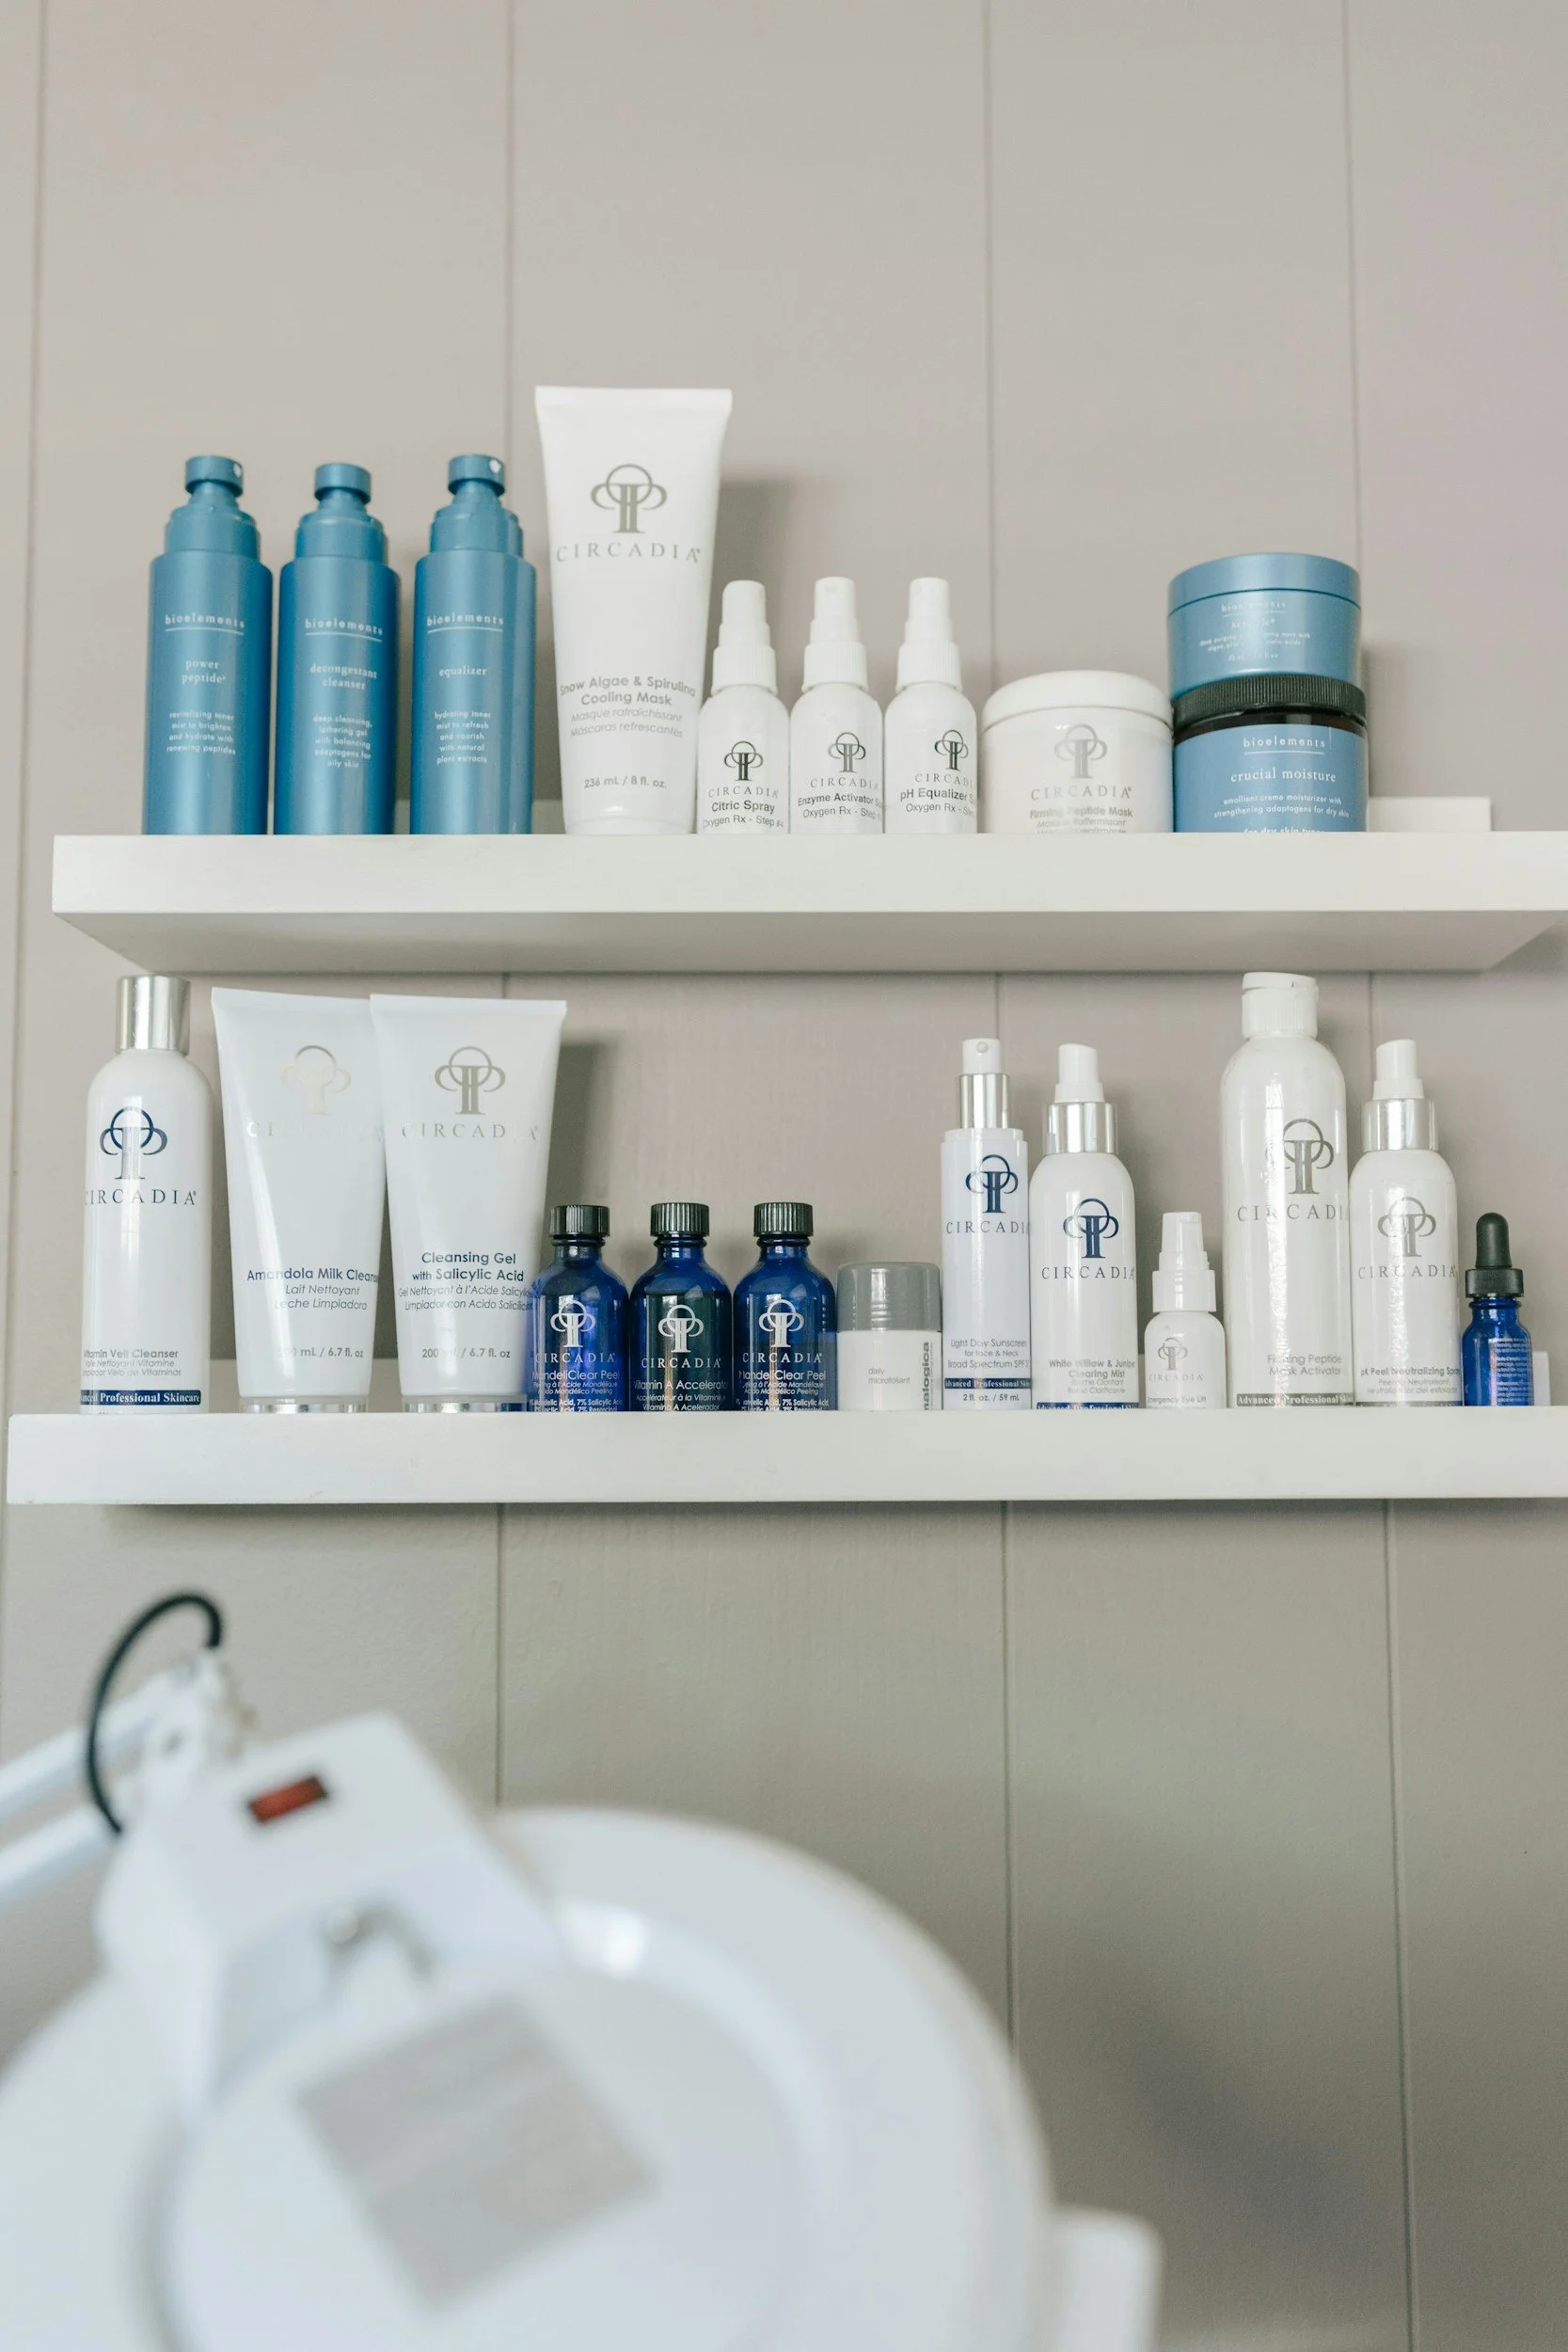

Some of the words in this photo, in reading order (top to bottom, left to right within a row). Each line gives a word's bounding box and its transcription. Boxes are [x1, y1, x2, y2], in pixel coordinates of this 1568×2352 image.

[556, 542, 698, 563] CIRCADIA
[165, 612, 245, 628] bioelements
[427, 612, 504, 627] bioelements
[305, 618, 383, 636] bioelements
[185, 660, 219, 670] power
[309, 663, 377, 678] decongestant
[439, 665, 487, 678] equalizer
[323, 676, 366, 690] cleanser
[589, 676, 628, 689] Algae
[634, 676, 642, 686] &
[580, 691, 632, 705] Cooling
[637, 692, 672, 706] Mask
[1243, 736, 1325, 748] bioelements
[631, 776, 637, 785] 8
[1230, 767, 1276, 783] crucial
[1282, 769, 1337, 783] moisture
[799, 795, 831, 806] Enzyme
[834, 793, 874, 803] Activator
[900, 788, 914, 802] pH
[918, 788, 967, 801] Equalizer
[1031, 786, 1130, 801] CIRCADIA
[712, 801, 739, 812] Citric
[744, 800, 774, 814] Spray
[803, 807, 835, 818] Oxygen
[839, 806, 851, 815] Rx
[906, 803, 941, 813] Oxygen
[944, 803, 956, 812] Rx
[1109, 806, 1132, 818] Mask
[1266, 805, 1311, 814] adaptogens
[756, 816, 774, 826] Step
[421, 1251, 489, 1265] Cleansing
[494, 1253, 515, 1264] Gel
[318, 1268, 342, 1279] Milk
[412, 1272, 432, 1280] with
[436, 1268, 492, 1281] Salicylic
[497, 1270, 524, 1281] Acid
[286, 1284, 306, 1295] Lait
[309, 1285, 360, 1296] Nettoyant
[456, 1285, 463, 1295] à
[313, 1298, 368, 1310] Limpiadora
[448, 1300, 467, 1309] con
[132, 1349, 179, 1358] Cleanser
[328, 1348, 342, 1357] 6.7
[743, 1353, 821, 1363] CIRCADIA
[641, 1358, 721, 1368] CIRCADIA
[970, 1360, 1012, 1369] Spectrum
[807, 1371, 826, 1380] Peel
[100, 1393, 160, 1402] Professional
